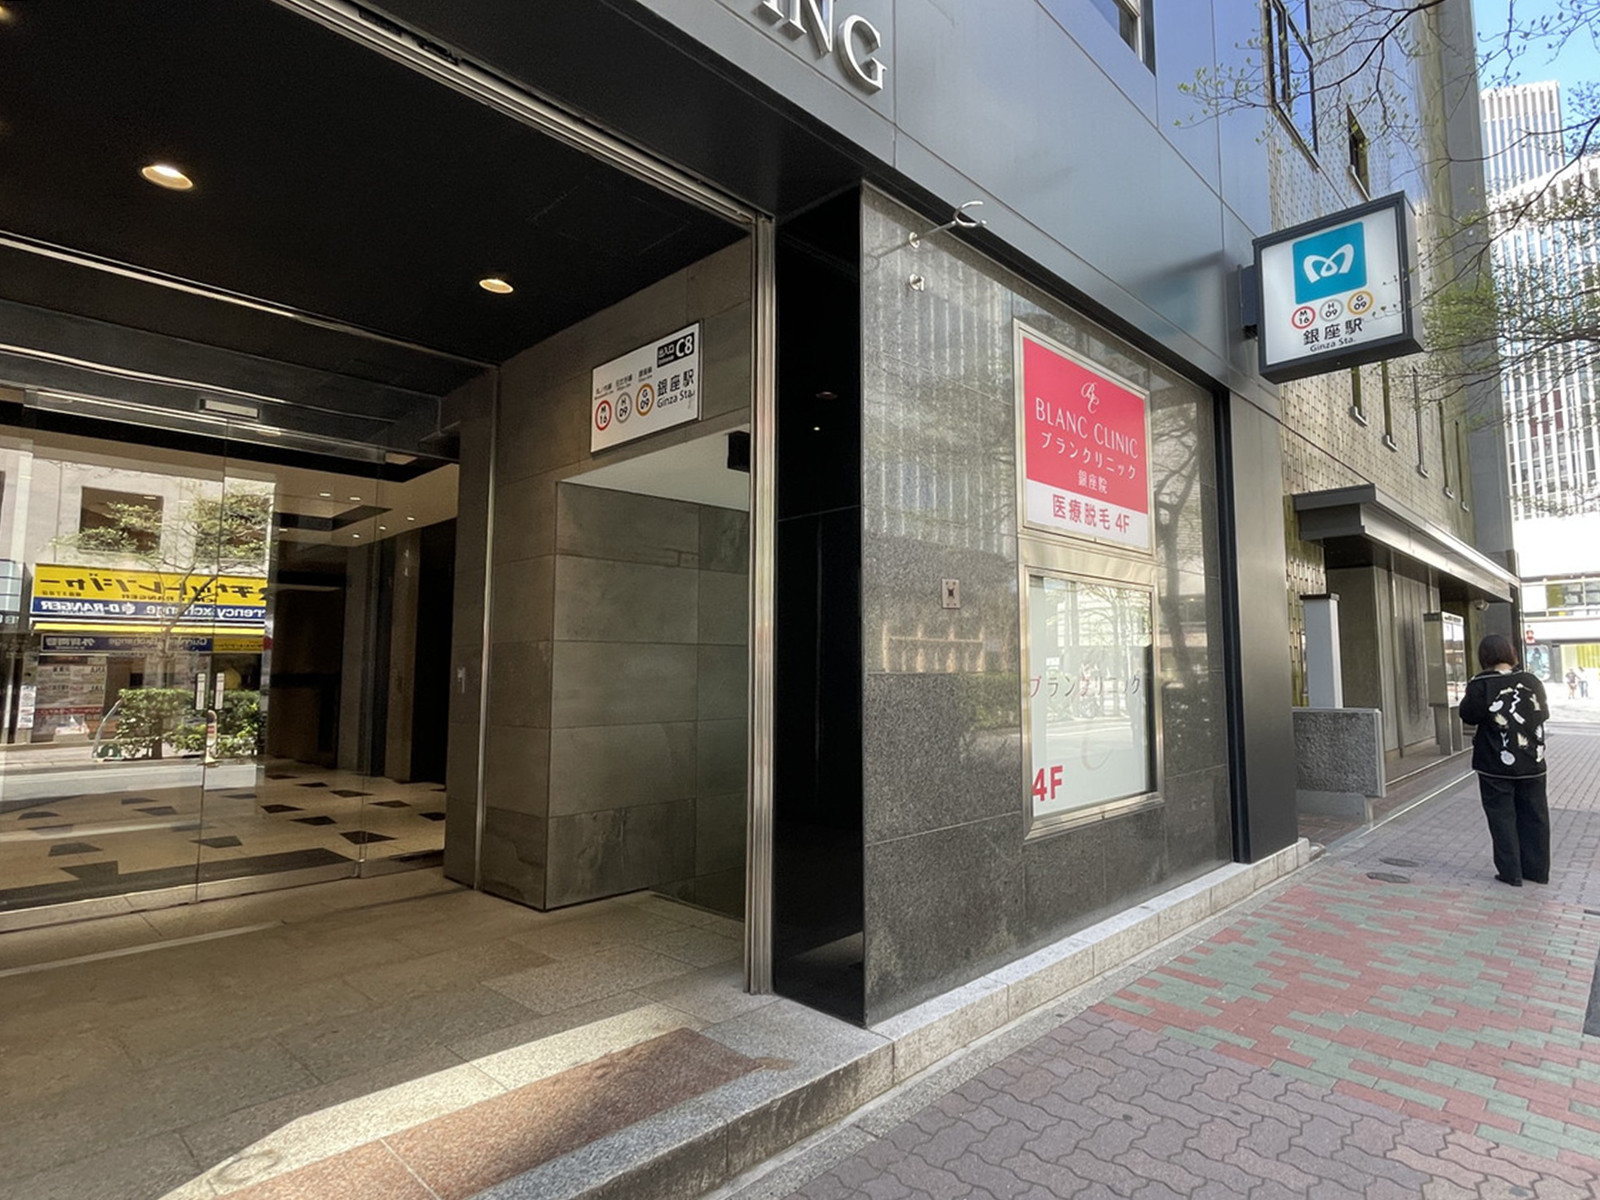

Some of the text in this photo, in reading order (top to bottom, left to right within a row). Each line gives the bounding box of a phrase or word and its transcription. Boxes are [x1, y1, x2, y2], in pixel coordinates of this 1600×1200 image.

[760, 0, 887, 92] NG
[1325, 309, 1338, 318] 09
[1353, 301, 1367, 310] 09
[1298, 317, 1310, 325] 16
[1303, 318, 1363, 345] 銀座駅
[675, 336, 693, 357] C8
[1309, 337, 1357, 352] Ginza Sta.
[657, 369, 694, 397] 銀座駅
[657, 396, 678, 408] Ginza
[1035, 397, 1139, 459] BLANC CLINIC
[1041, 431, 1137, 480] ブランクリニック
[1078, 469, 1108, 494] 銀座院
[1052, 494, 1131, 534] 医療脱毛 4F
[1030, 765, 1064, 802] 4F
